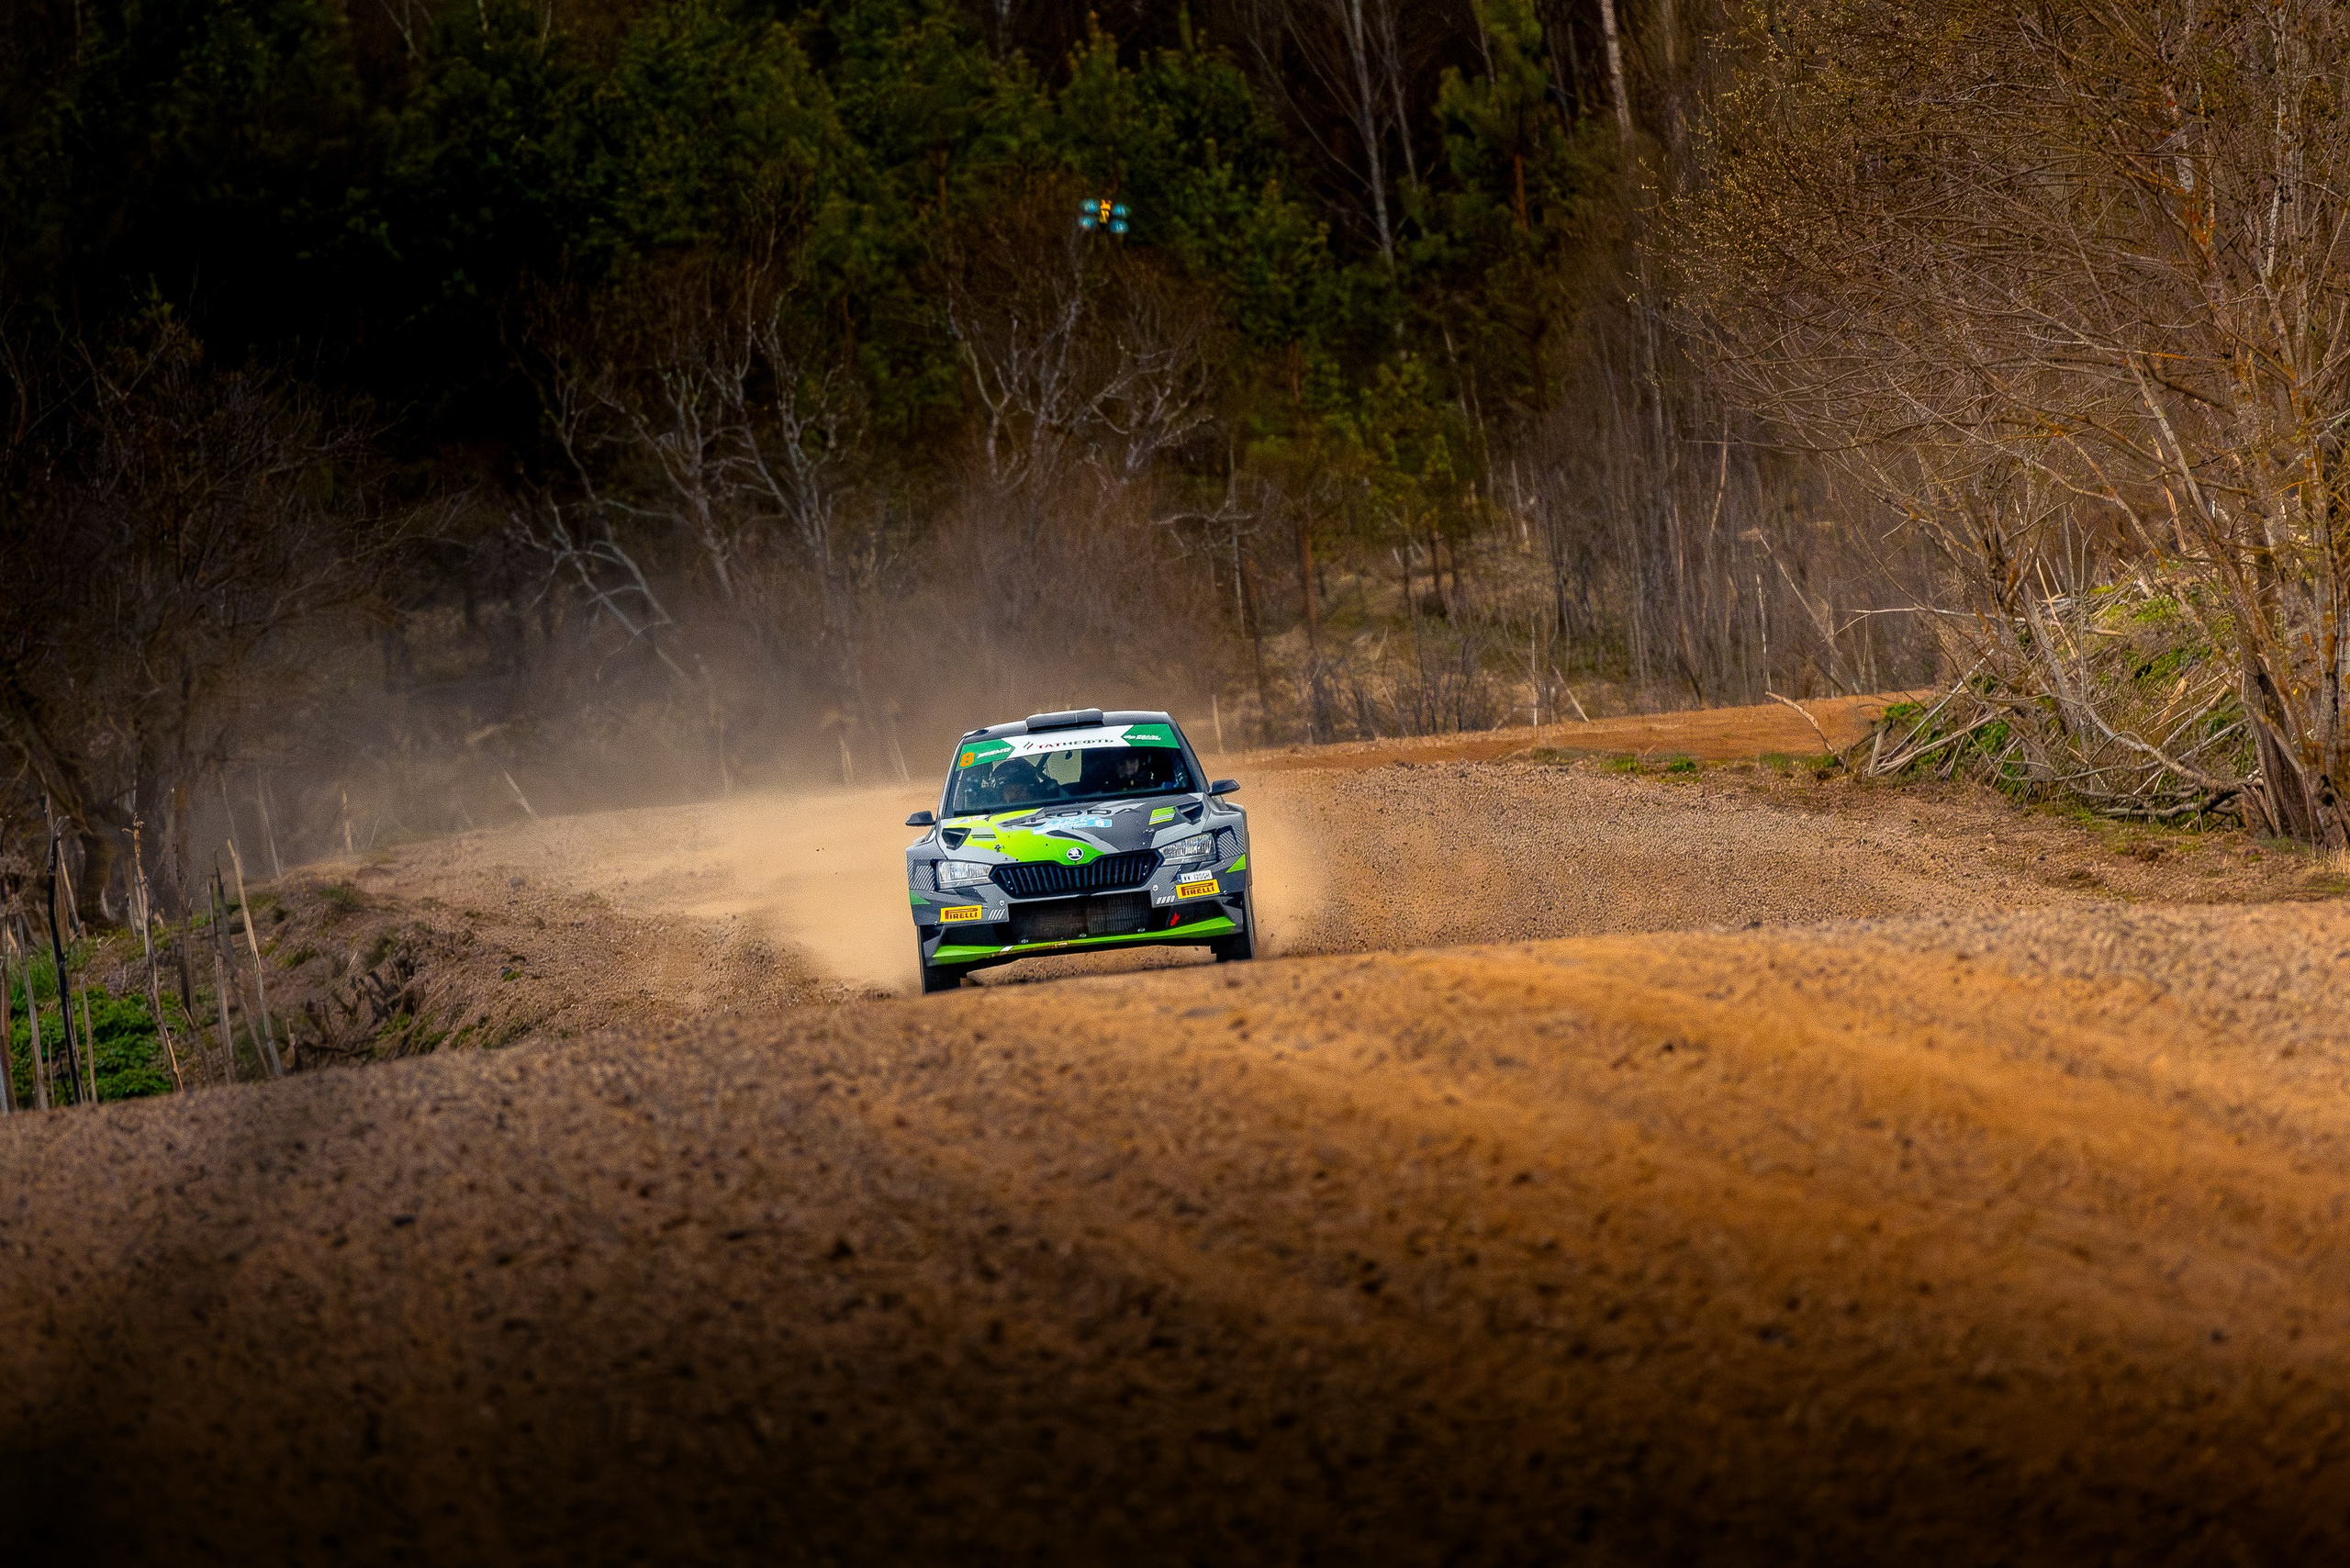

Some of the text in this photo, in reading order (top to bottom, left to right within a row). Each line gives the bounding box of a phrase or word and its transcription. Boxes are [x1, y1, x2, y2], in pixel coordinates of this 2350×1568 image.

[959, 752, 975, 767] 8
[1181, 882, 1214, 896] PIRELLI
[944, 907, 979, 920] PIRELLI
